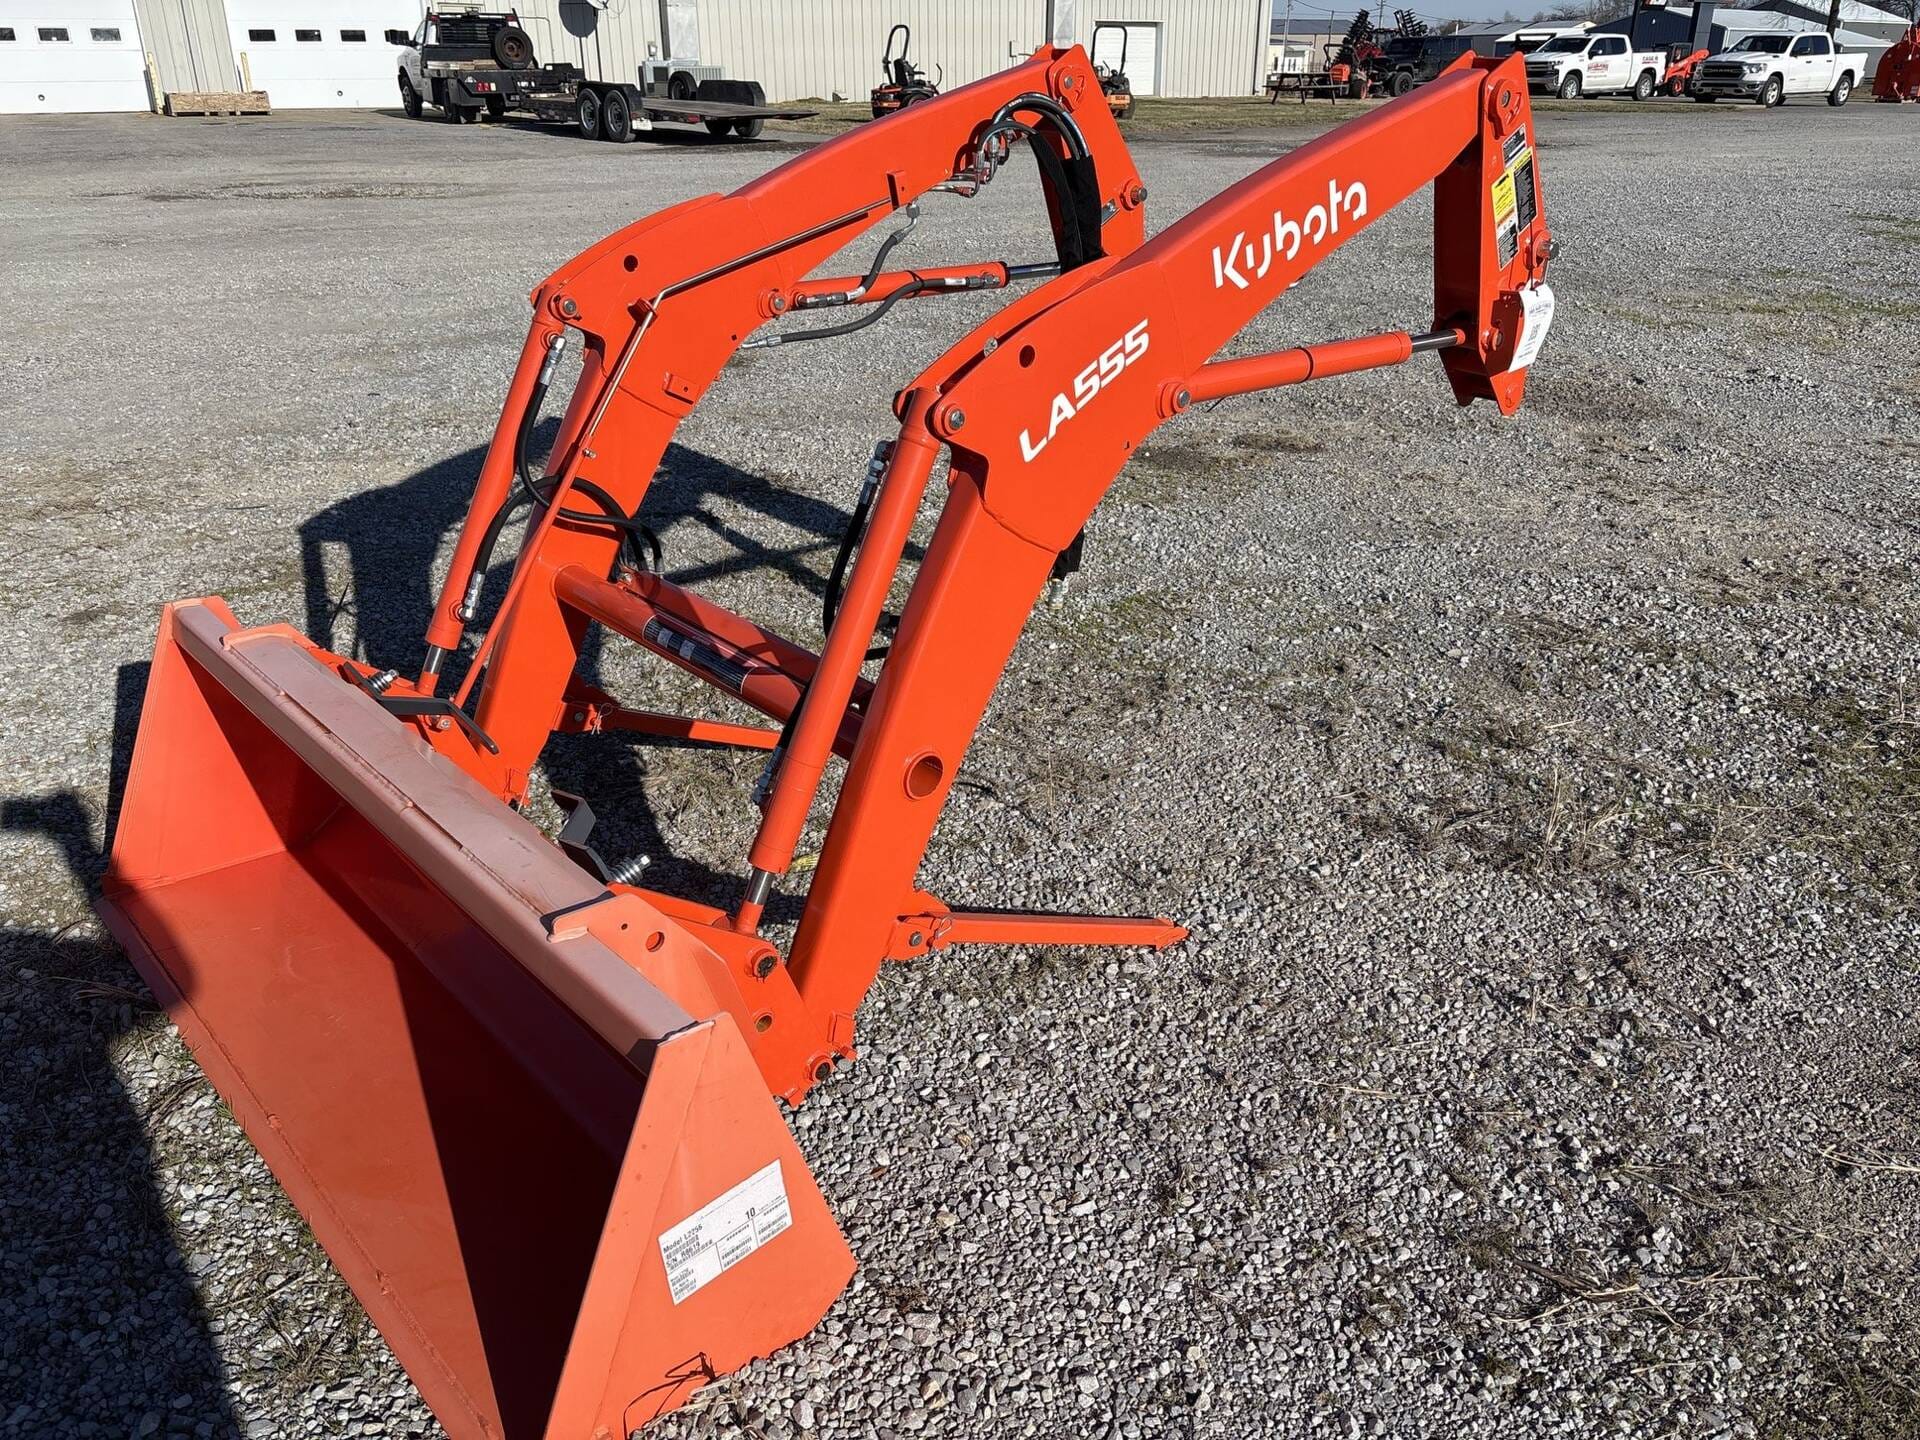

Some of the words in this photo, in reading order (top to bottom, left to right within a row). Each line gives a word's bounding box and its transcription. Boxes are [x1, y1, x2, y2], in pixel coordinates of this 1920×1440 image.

[1212, 179, 1367, 289] Kubota
[1019, 318, 1149, 462] LA555
[746, 1207, 756, 1220] 10
[663, 1237, 683, 1254] Model
